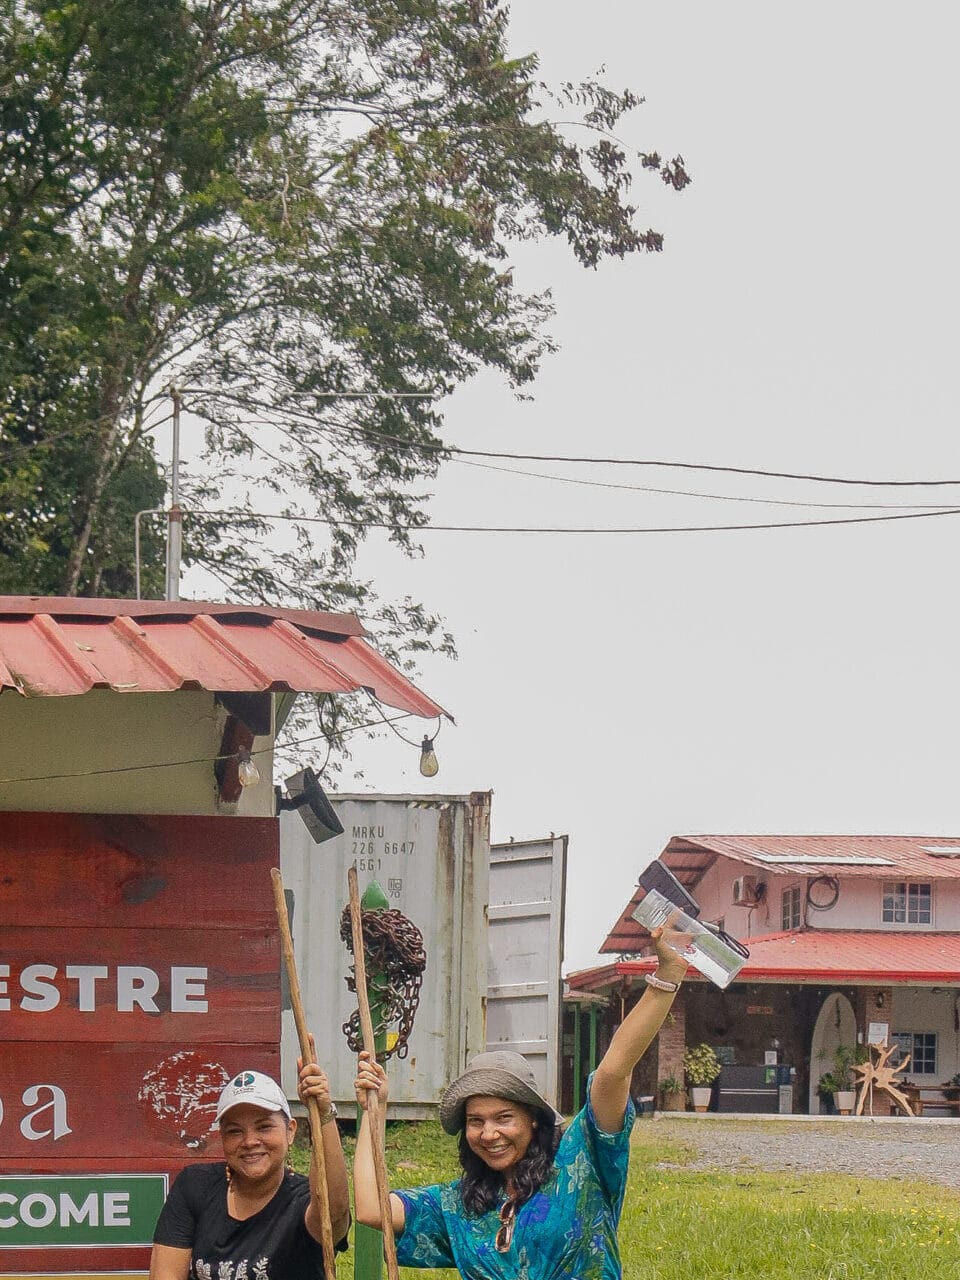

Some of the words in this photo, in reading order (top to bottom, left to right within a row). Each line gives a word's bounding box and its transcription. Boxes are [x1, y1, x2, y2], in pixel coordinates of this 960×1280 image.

[352, 826, 384, 838] MRKU
[352, 842, 374, 854] 226
[384, 842, 414, 855] 6647
